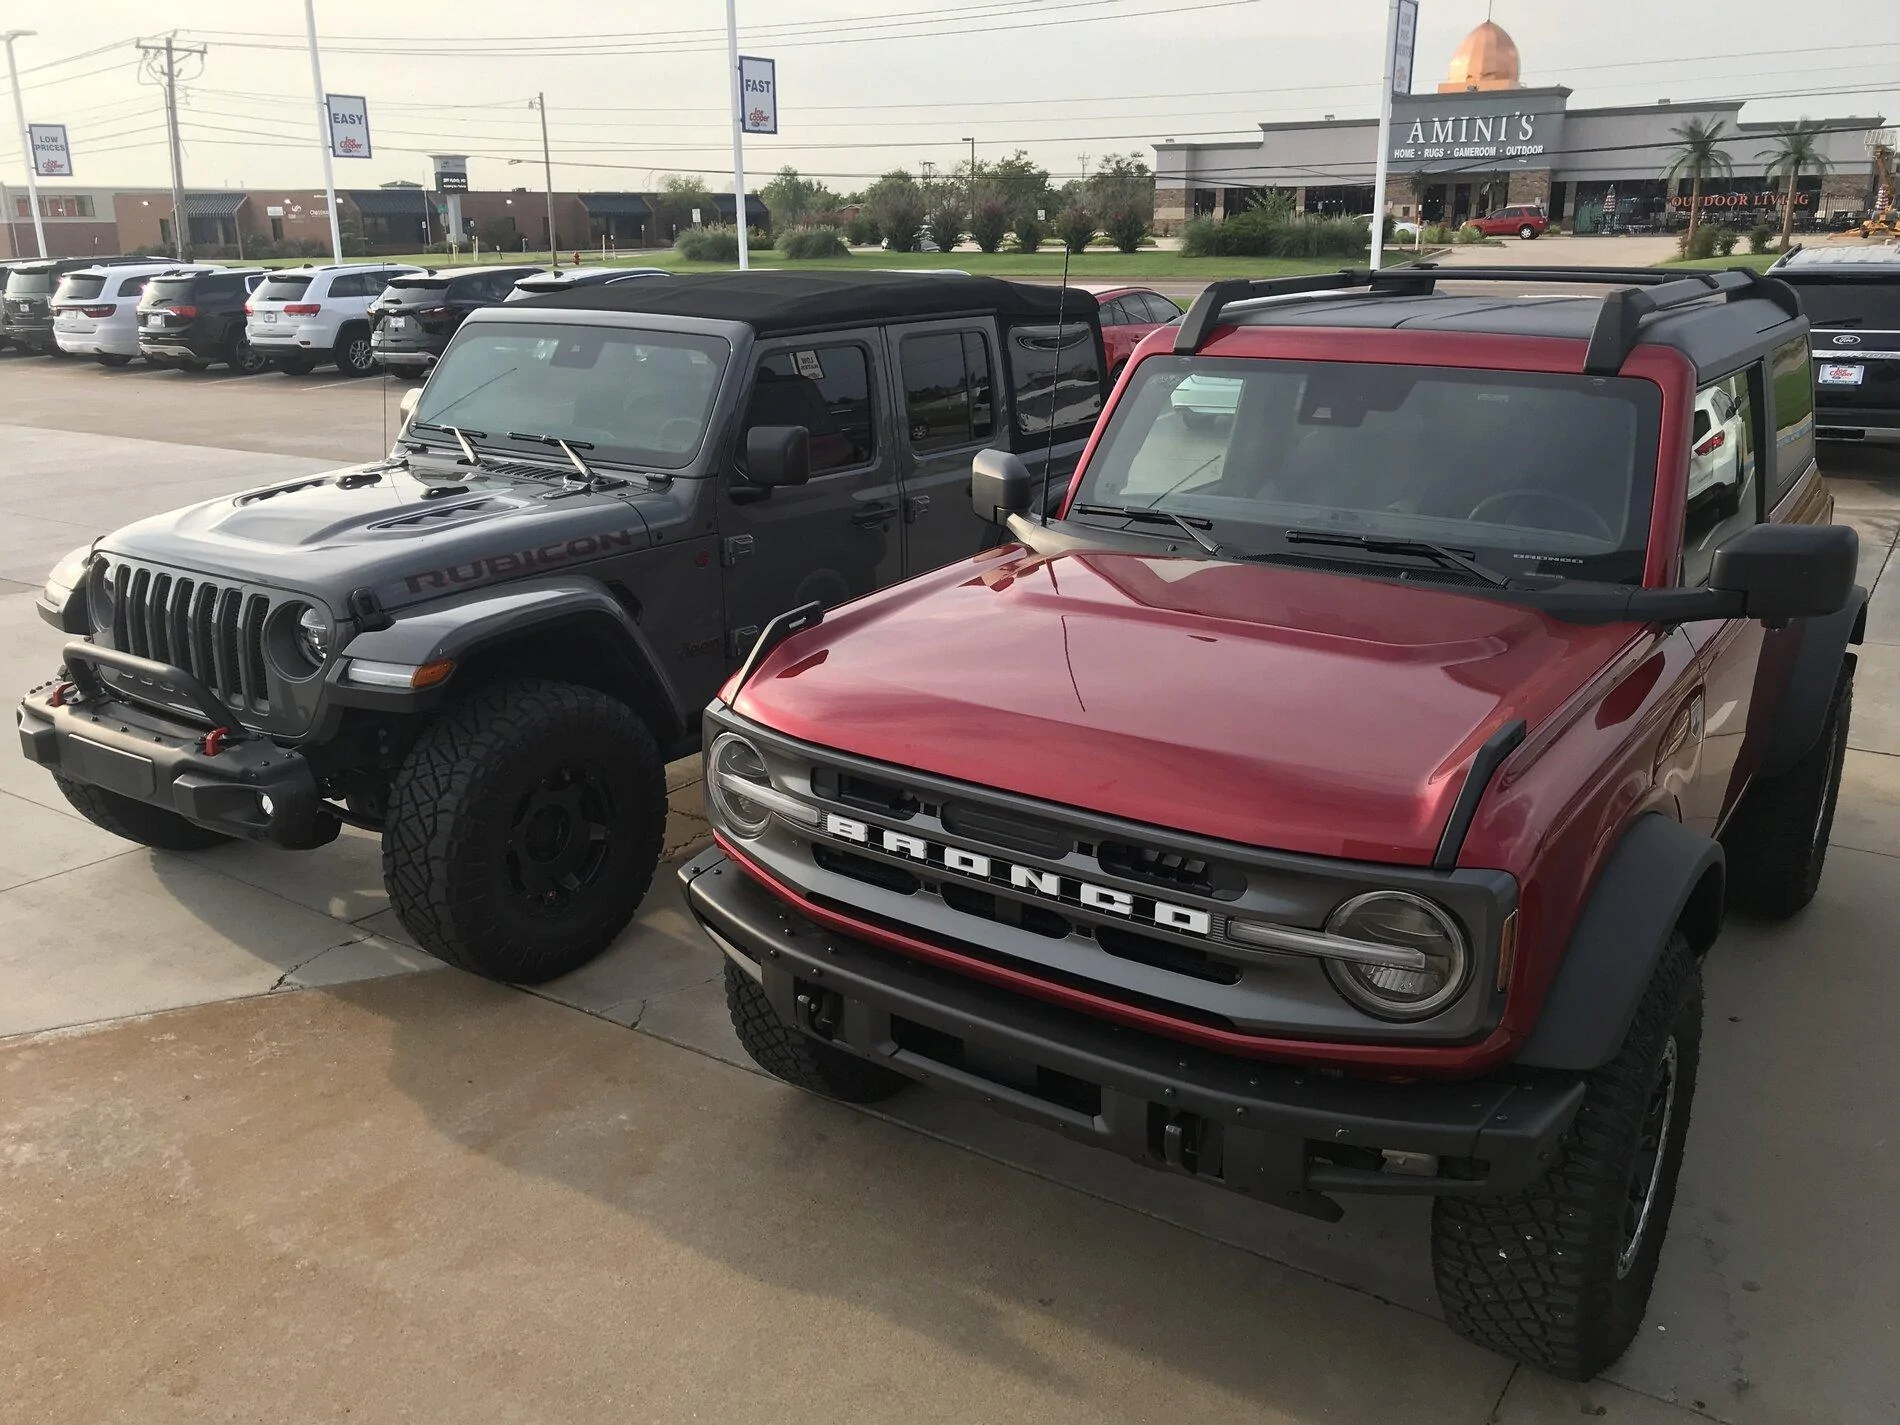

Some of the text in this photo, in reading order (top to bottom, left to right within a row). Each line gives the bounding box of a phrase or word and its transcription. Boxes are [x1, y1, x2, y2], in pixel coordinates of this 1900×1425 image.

[745, 79, 771, 93] FAST
[332, 112, 364, 125] EASY
[1406, 111, 1535, 144] AMINI'S
[39, 135, 58, 143] LOW
[34, 144, 66, 152] PRICES
[1394, 145, 1544, 158] HOME RUGS GAMEROOM OUTDOOR
[1671, 194, 1748, 207] OUDOOR
[404, 529, 631, 594] RUBICON
[1513, 553, 1584, 564] BRONCO
[826, 812, 1212, 935] BRONCO
